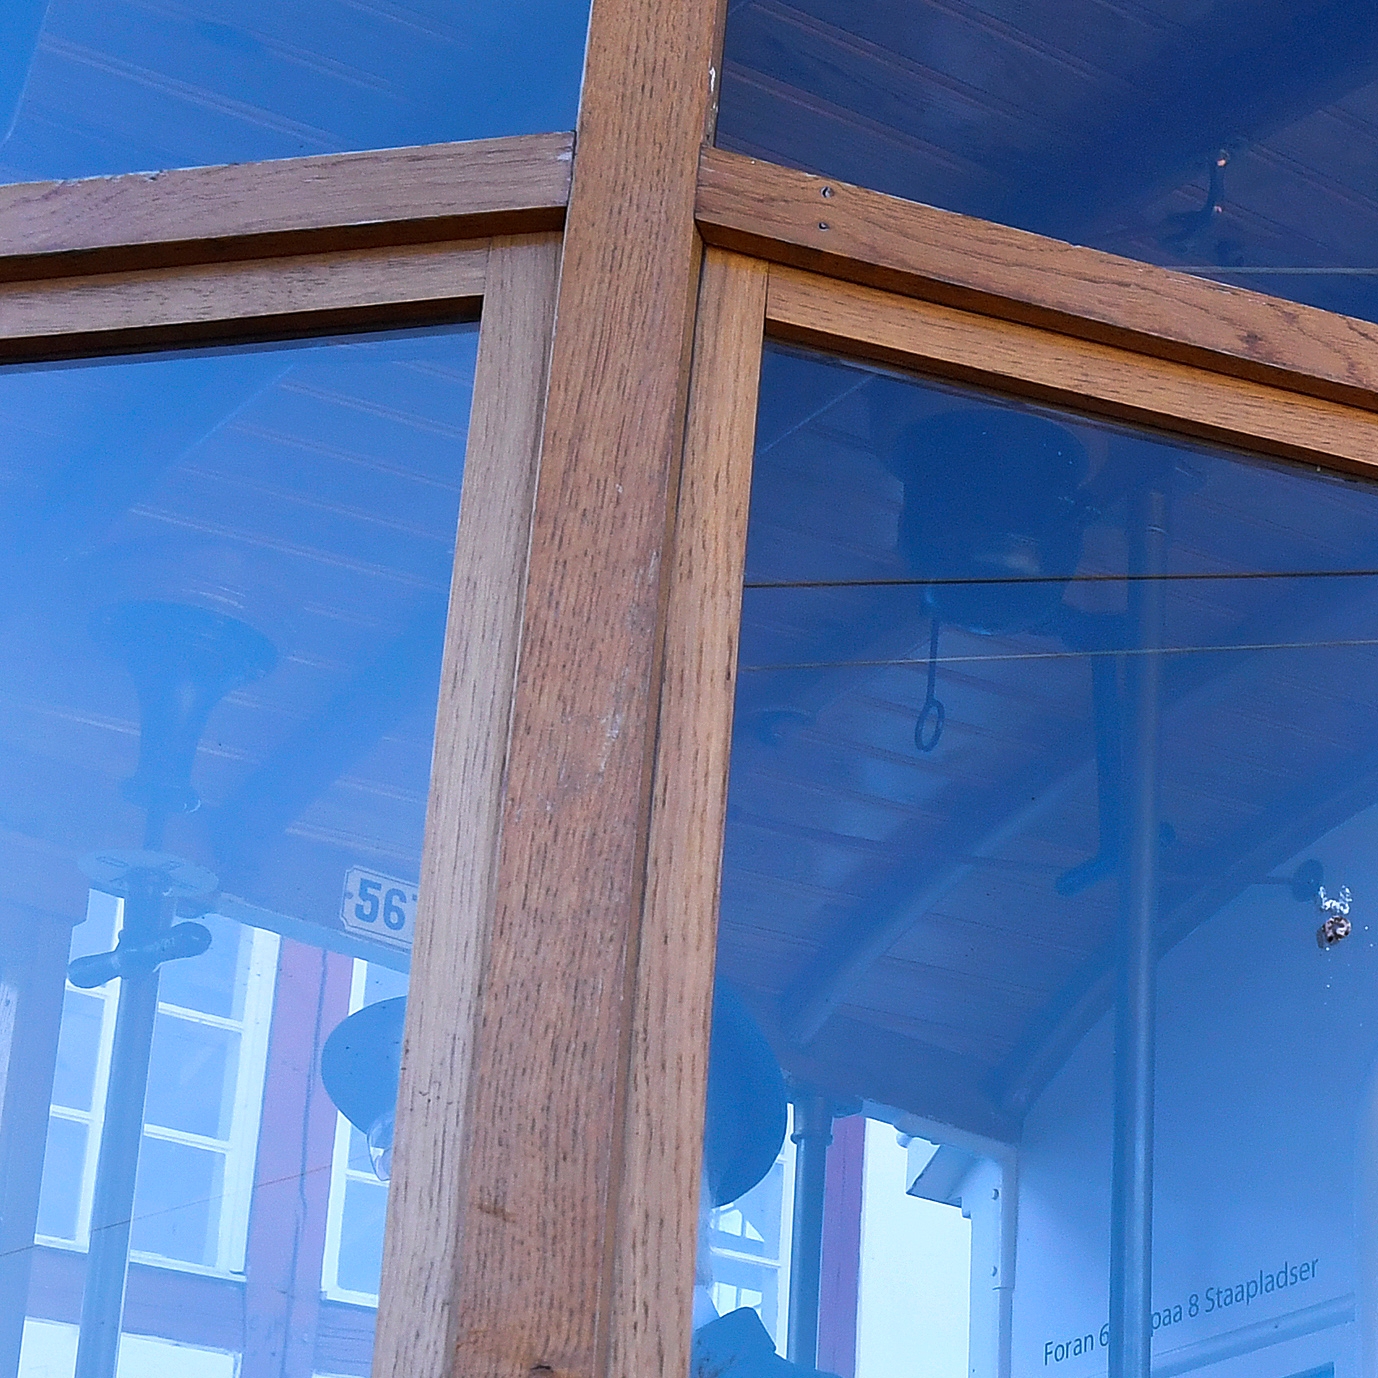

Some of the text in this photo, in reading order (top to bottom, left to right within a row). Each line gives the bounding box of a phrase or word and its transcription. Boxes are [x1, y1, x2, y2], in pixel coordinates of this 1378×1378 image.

[355, 877, 418, 931] 56
[1043, 1334, 1095, 1366] Foran
[1188, 1294, 1199, 1318] 8
[1204, 1257, 1319, 1315] Staapladser
